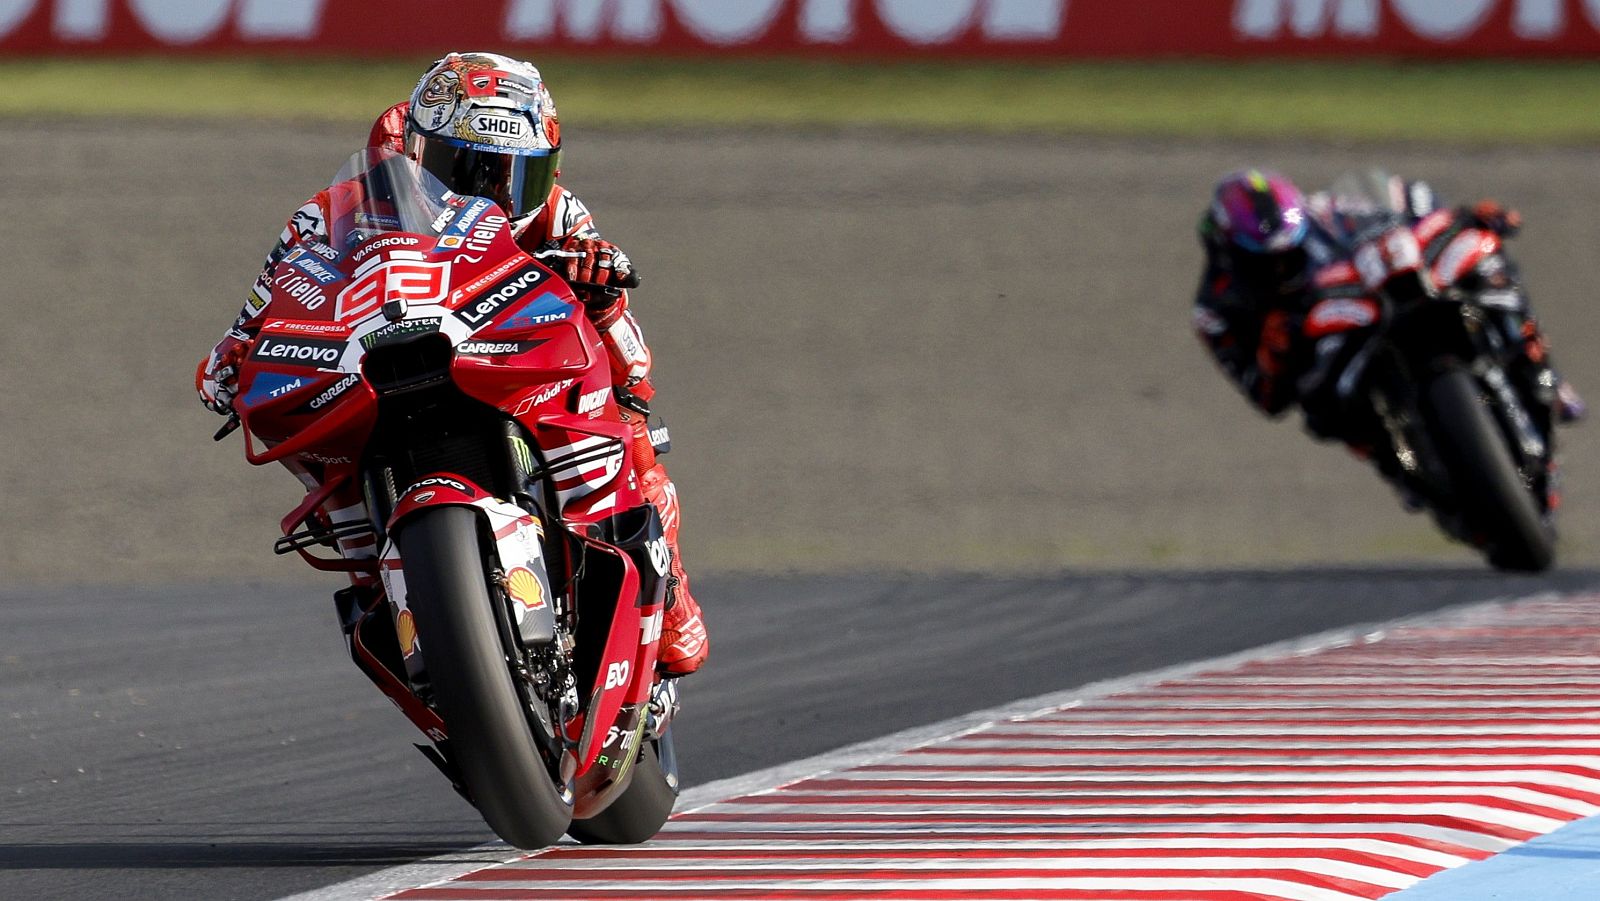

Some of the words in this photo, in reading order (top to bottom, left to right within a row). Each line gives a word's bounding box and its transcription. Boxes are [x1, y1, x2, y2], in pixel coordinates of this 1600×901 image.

[478, 117, 521, 136] SHOEI
[431, 207, 456, 233] WRS
[455, 199, 489, 232] ADVANCE
[465, 215, 508, 252] riello
[311, 242, 339, 260] WRS
[352, 237, 419, 262] VARGROUP
[295, 258, 336, 283] ADVANCE
[465, 256, 526, 293] FRECCIAROSSA
[281, 276, 327, 311] riello
[460, 270, 541, 324] Lenovo
[284, 323, 346, 333] FRECCIAROSSA
[377, 317, 440, 338] MONSTER
[532, 312, 566, 324] TIM
[257, 339, 339, 362] Lenovo
[457, 342, 519, 354] CARRERA
[270, 379, 301, 397] TIM
[310, 374, 359, 409] CARRERA
[578, 386, 611, 414] DUCATI
